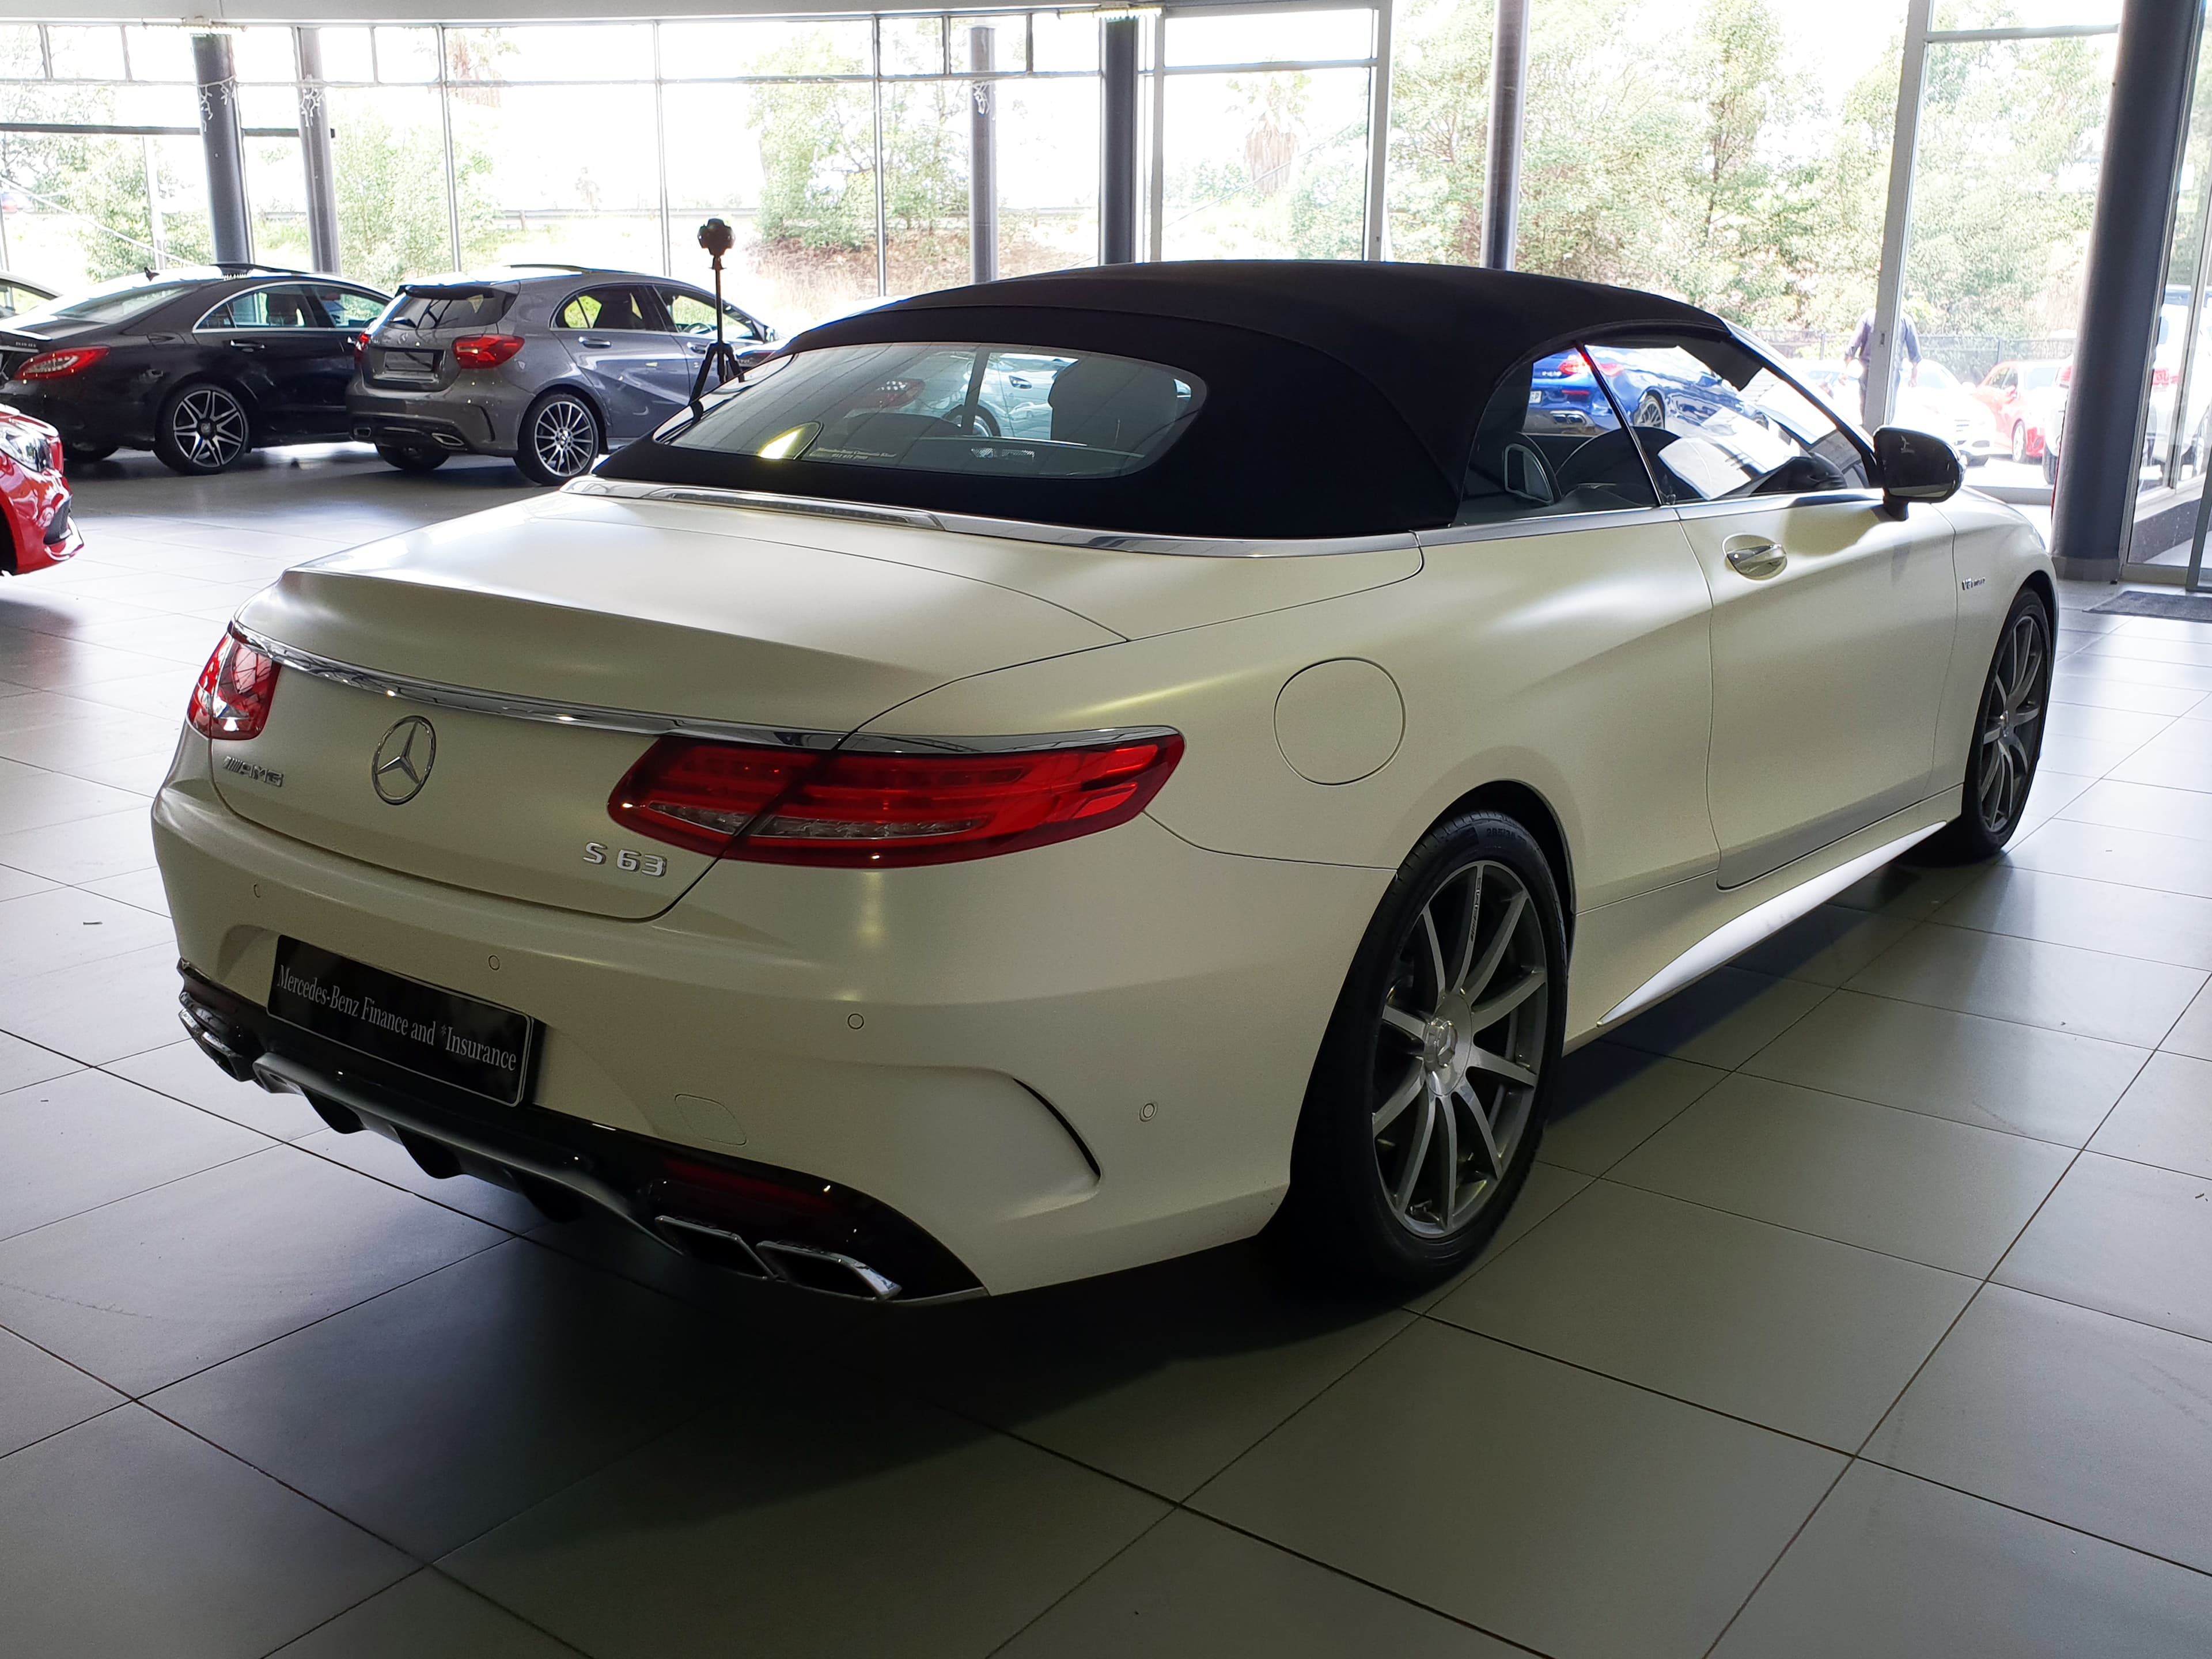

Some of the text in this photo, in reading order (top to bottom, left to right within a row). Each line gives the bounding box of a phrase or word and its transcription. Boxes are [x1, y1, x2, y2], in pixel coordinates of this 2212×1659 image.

[239, 762, 284, 787] AMG
[582, 842, 667, 877] S 63
[276, 964, 358, 1017] Mercedes-Benz
[361, 996, 408, 1036] Finance
[411, 1020, 436, 1046] and
